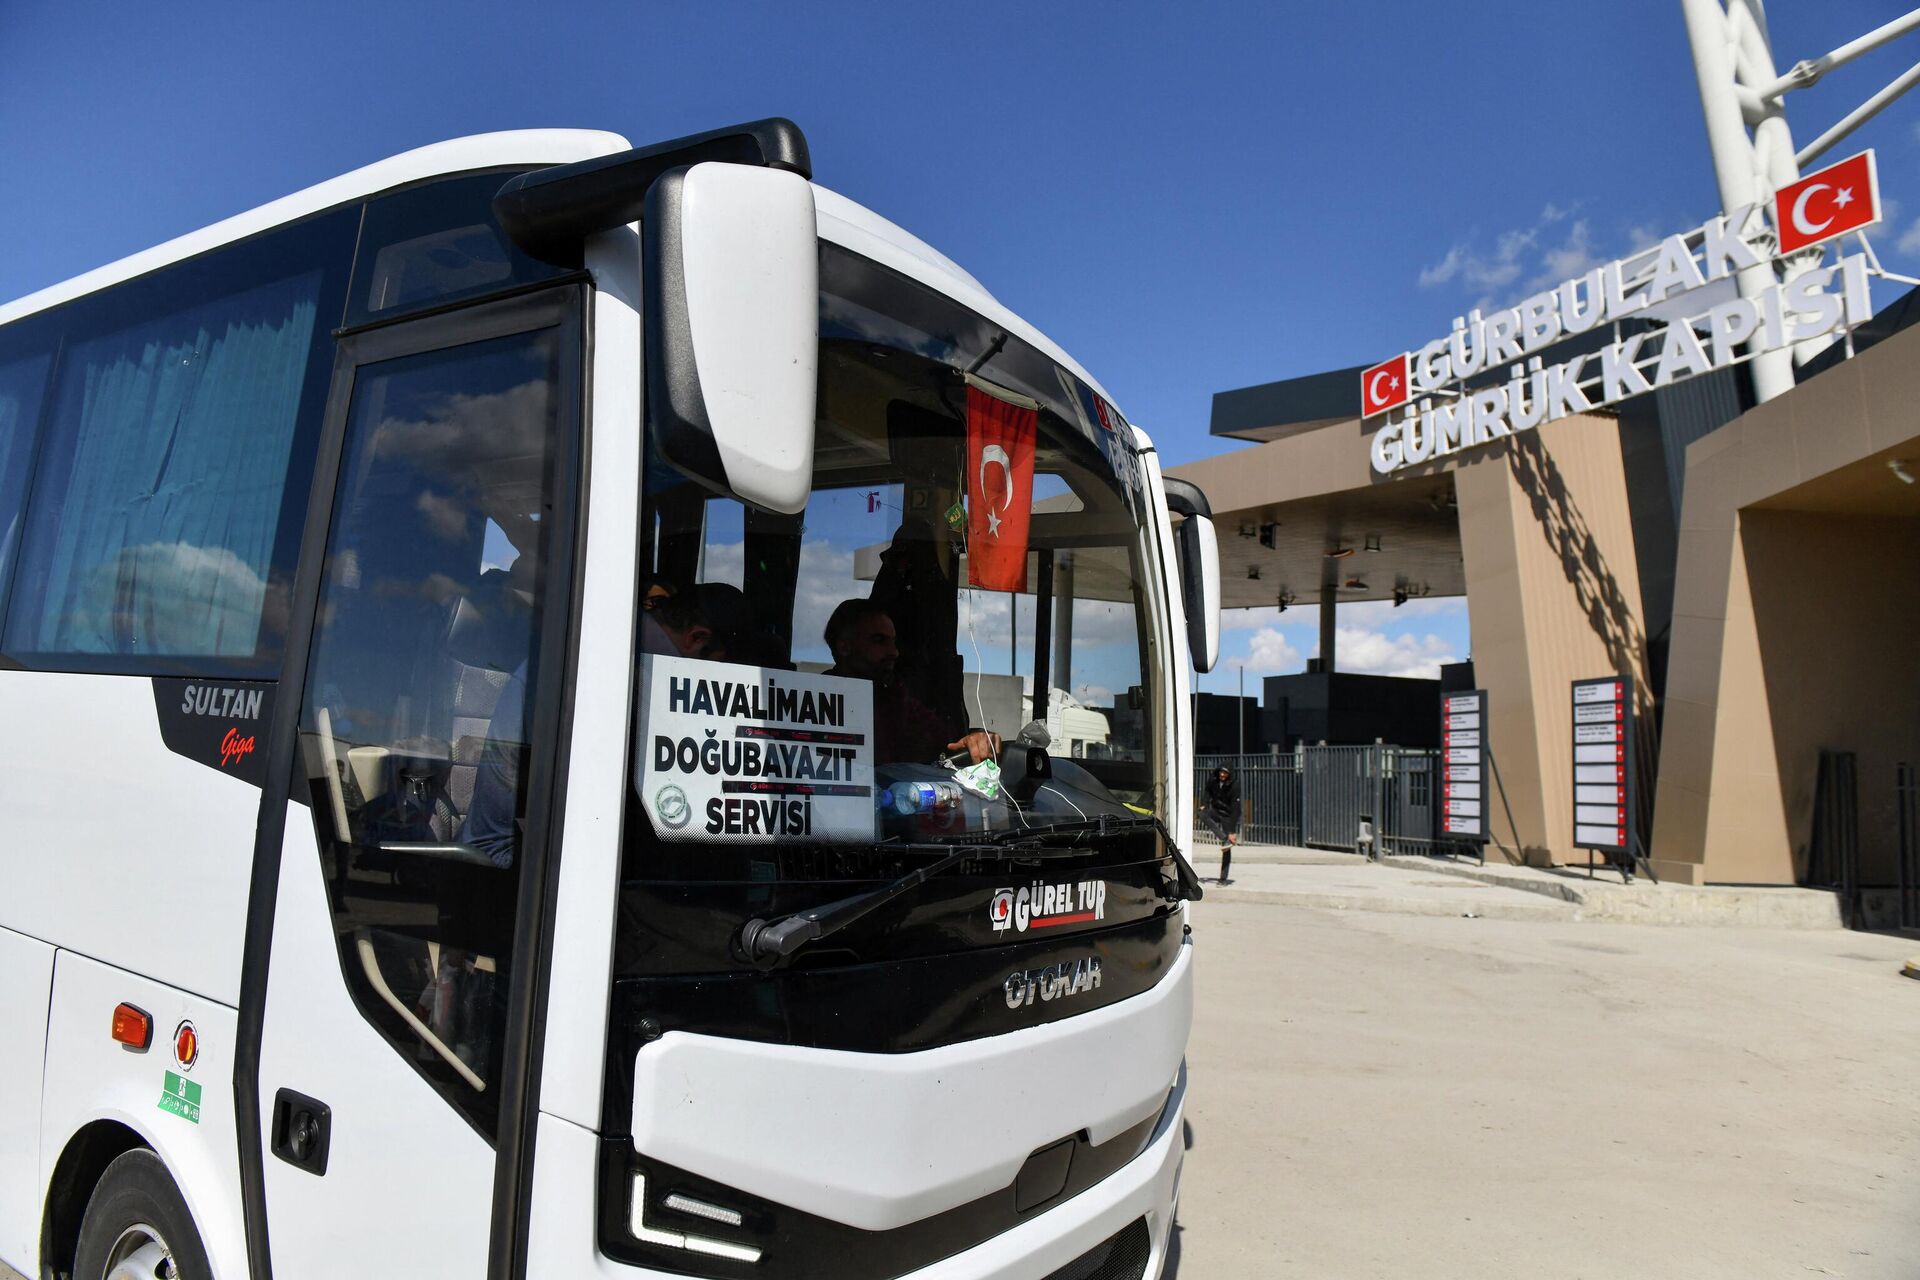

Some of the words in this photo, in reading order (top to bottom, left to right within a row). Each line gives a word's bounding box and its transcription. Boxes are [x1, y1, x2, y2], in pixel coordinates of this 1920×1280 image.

[1415, 201, 1768, 392] GÜRBULAK
[1370, 354, 1593, 475] GÜMRÜK
[1602, 252, 1873, 403] KAPISI
[181, 684, 265, 720] SULTAN
[669, 676, 845, 727] HAVALİMANI
[220, 727, 256, 767] Giga
[654, 728, 857, 782] DOĞUBAYAZIT
[704, 792, 812, 836] SERVİSİ
[1015, 879, 1074, 933] GÜREL
[1078, 880, 1106, 921] TUR
[1003, 956, 1103, 1009] OTOKAR
